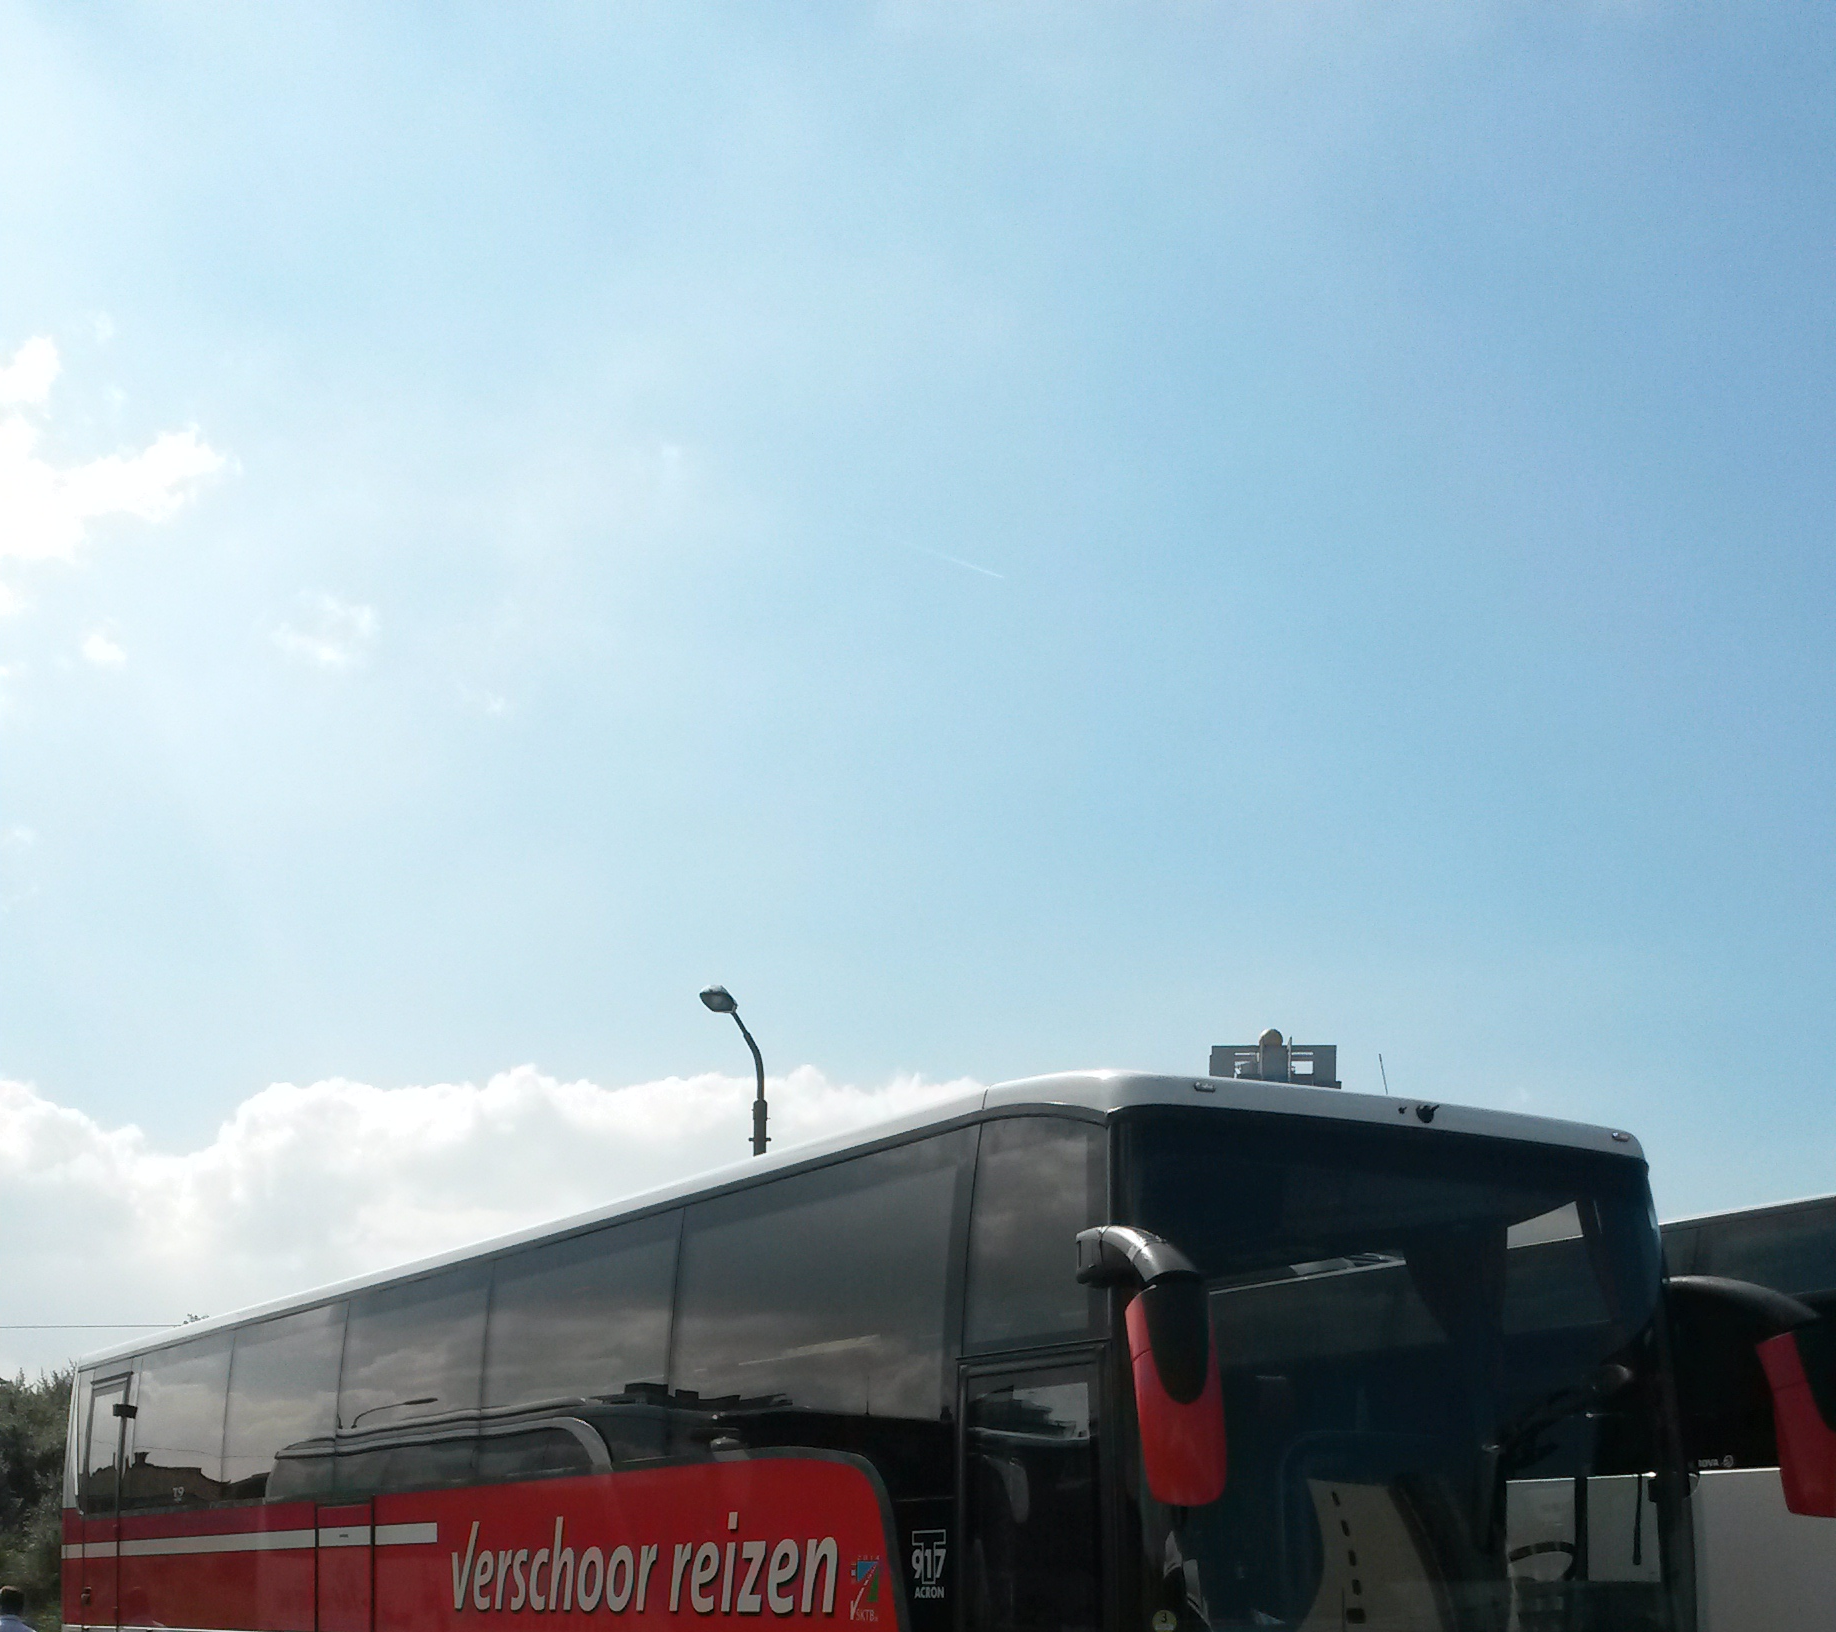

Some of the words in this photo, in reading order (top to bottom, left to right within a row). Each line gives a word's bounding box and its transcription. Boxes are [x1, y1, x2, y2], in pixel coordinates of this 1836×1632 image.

[451, 1515, 657, 1614] Verschoor
[668, 1511, 838, 1615] reizen
[911, 1548, 947, 1579] 917
[914, 1586, 945, 1599] ACRON
